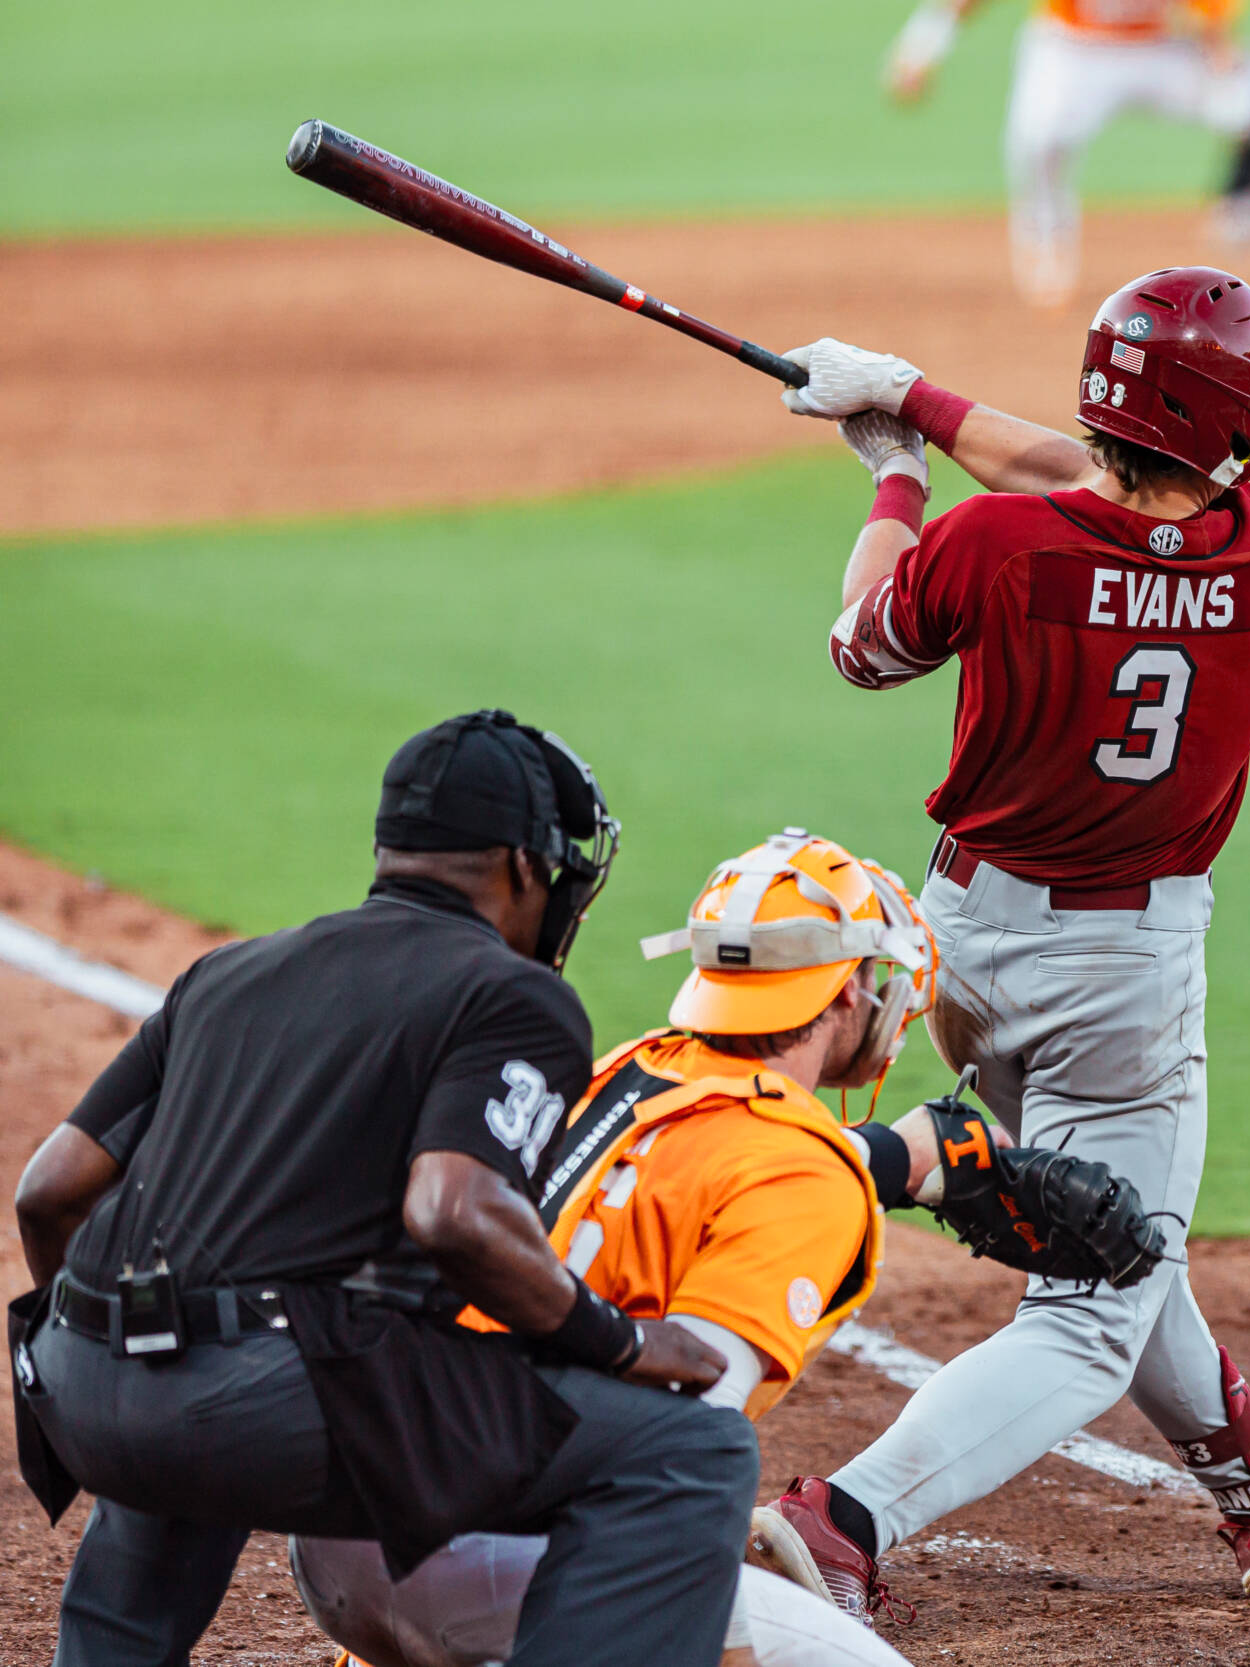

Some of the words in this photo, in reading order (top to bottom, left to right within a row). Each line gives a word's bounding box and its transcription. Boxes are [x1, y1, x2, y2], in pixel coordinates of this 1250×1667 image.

[1111, 382, 1126, 408] 3
[1150, 526, 1183, 554] SEC
[1088, 567, 1235, 629] EVANS
[1090, 643, 1198, 787] 3
[484, 1059, 565, 1180] 31
[944, 1120, 992, 1170] T
[1172, 1442, 1212, 1463] #3
